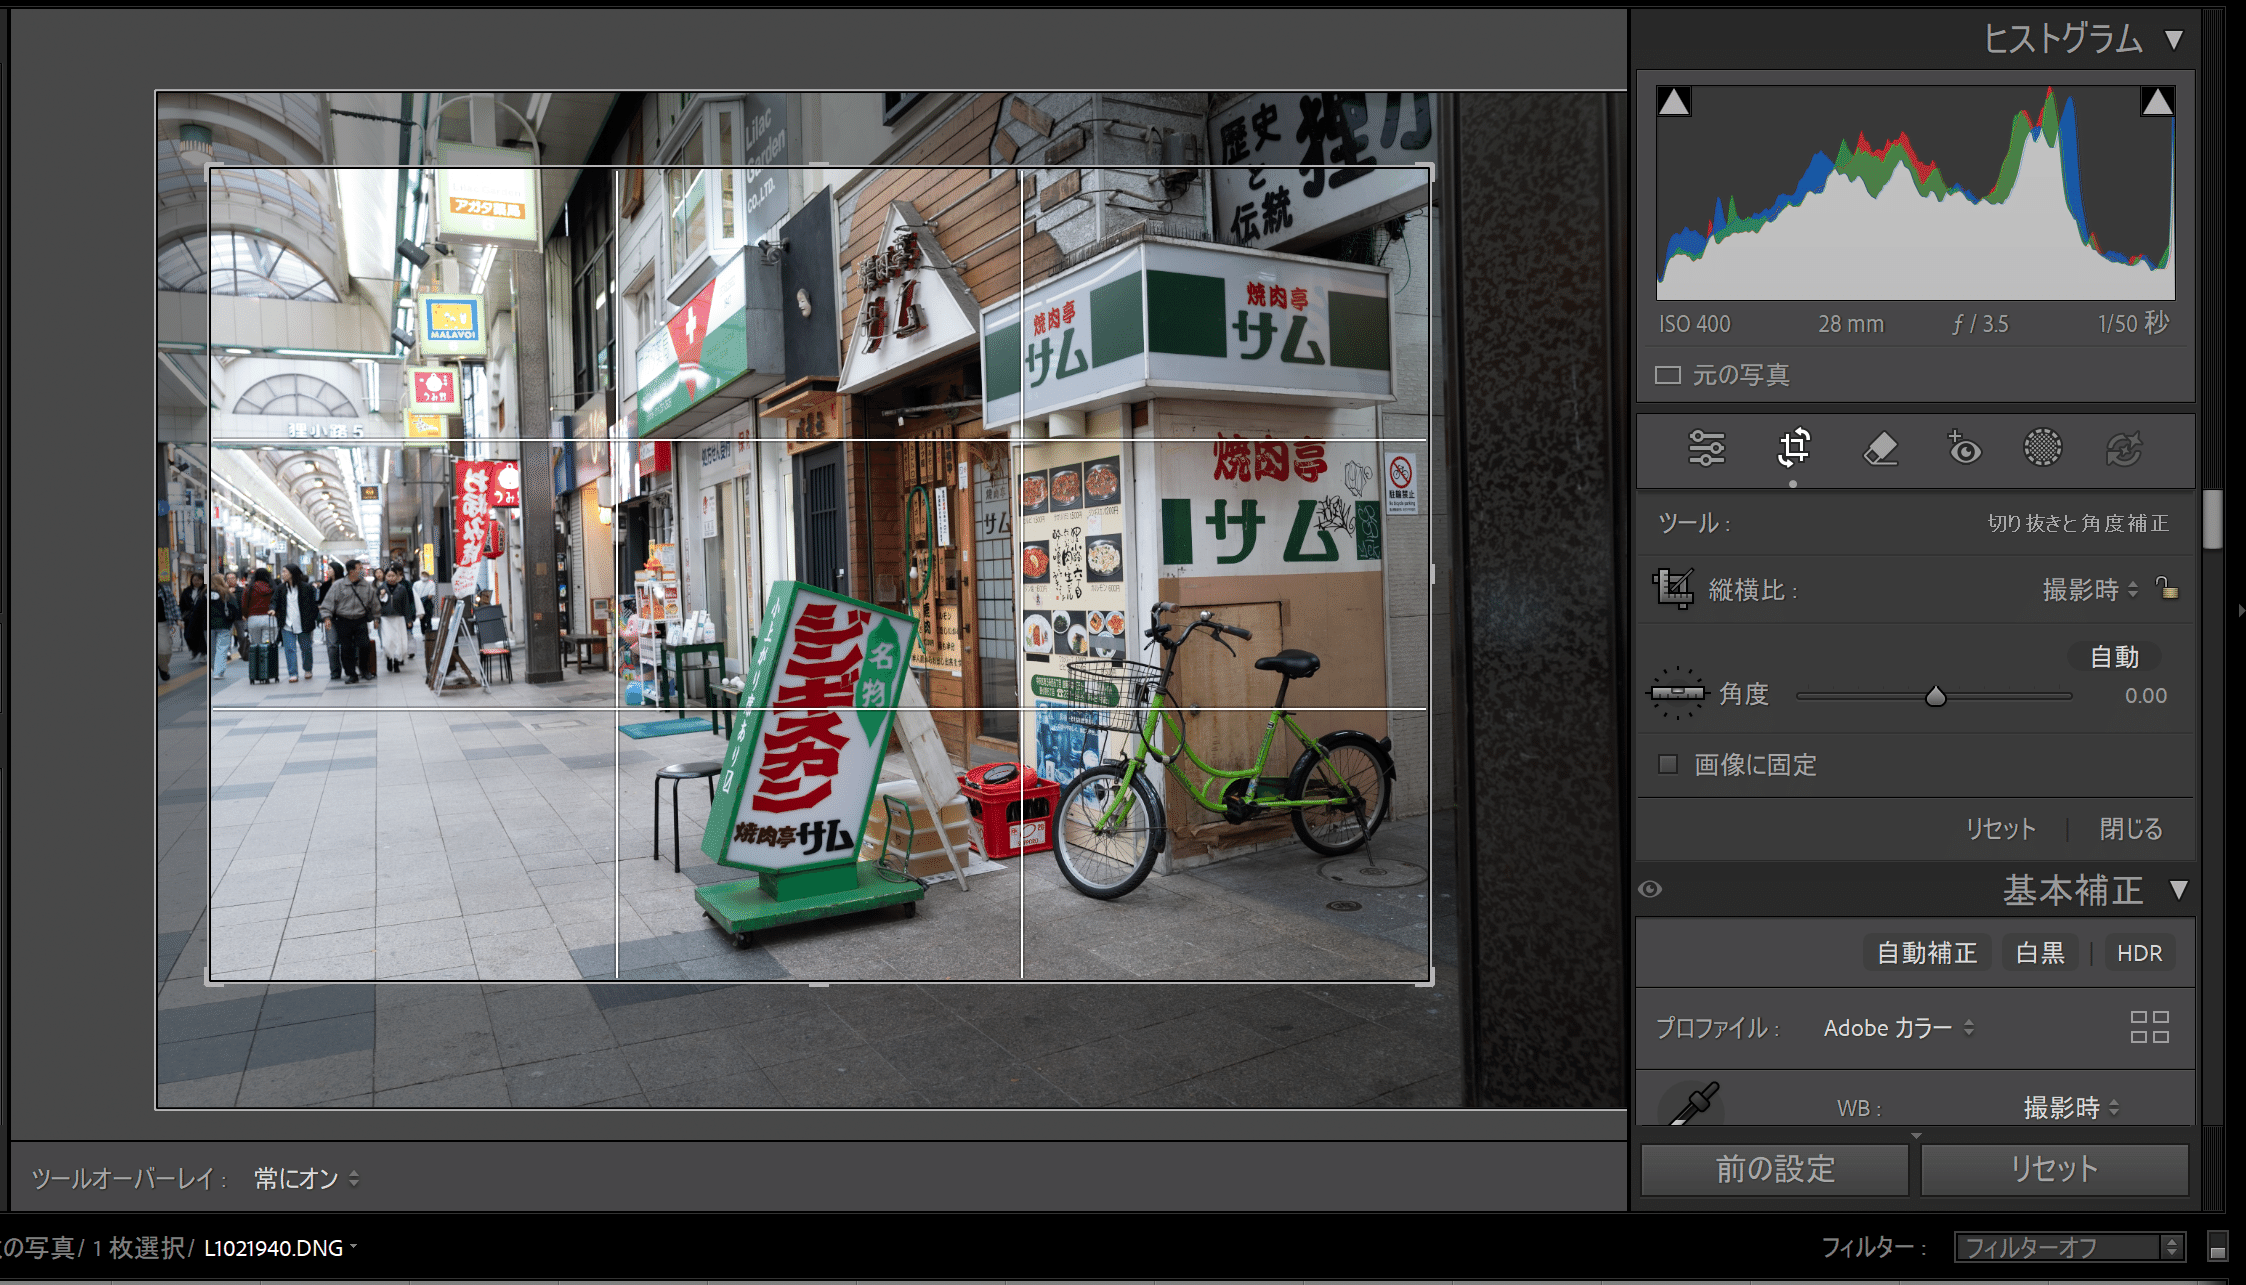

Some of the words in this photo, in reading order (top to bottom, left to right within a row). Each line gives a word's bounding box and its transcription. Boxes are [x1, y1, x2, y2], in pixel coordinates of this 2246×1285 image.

[1988, 21, 2143, 53] ヒストグラム
[746, 107, 771, 151] Lilac
[1220, 103, 1282, 165] 歴史
[746, 129, 786, 184] Garden
[1231, 185, 1293, 243] 伝統
[1246, 281, 1309, 311] 焼肉亭
[1033, 299, 1076, 337] 焼肉亭
[1661, 315, 1691, 332] ISO
[1697, 315, 1731, 332] 400
[1819, 315, 1841, 332] 28
[1848, 318, 1885, 333] mm
[1984, 315, 2009, 332] 3.5
[2099, 314, 2137, 333] 1/50
[2145, 310, 2170, 335] 秒
[431, 331, 476, 339] MALAVOI
[1232, 309, 1326, 366] サム
[1025, 327, 1089, 389] サム
[1694, 363, 1790, 387] 元の写真
[288, 422, 348, 439] 狸小路
[353, 424, 364, 439] 5
[1213, 431, 1328, 482] 焼肉亭
[494, 491, 520, 504] うみ
[1389, 490, 1415, 499] 駐輪禁止
[984, 511, 1011, 535] サム
[1205, 499, 1339, 565] サム
[1987, 513, 2170, 533] 切り抜きと角度補正
[2044, 578, 2119, 602] 撮影時
[2092, 645, 2139, 669] 自動
[862, 641, 894, 709] 名物
[1720, 682, 1769, 706] 角度
[2126, 687, 2168, 703] 0.00
[752, 603, 872, 813] ジンギスカン
[1695, 753, 1817, 777] 画像に固定
[1968, 818, 2036, 841] リセット
[2100, 818, 2163, 841] 閉じる
[2004, 873, 2144, 906] 基本補正
[1878, 941, 1978, 964] 自動補正
[2017, 941, 2065, 964] 白黒
[2118, 944, 2163, 962] HDR
[1824, 1019, 1889, 1037] Adobe
[1896, 1016, 1952, 1039] カラー
[2023, 1096, 2100, 1120] 撮影時
[254, 1167, 339, 1190] 常にオン
[1716, 1154, 1835, 1183] 前の設定
[2013, 1154, 2098, 1183] リセット
[0, 1236, 85, 1260] の写真/
[94, 1240, 101, 1257] 1
[205, 1239, 343, 1257] L1021940.DNG
[1966, 1237, 2098, 1259] フィルターオフ
